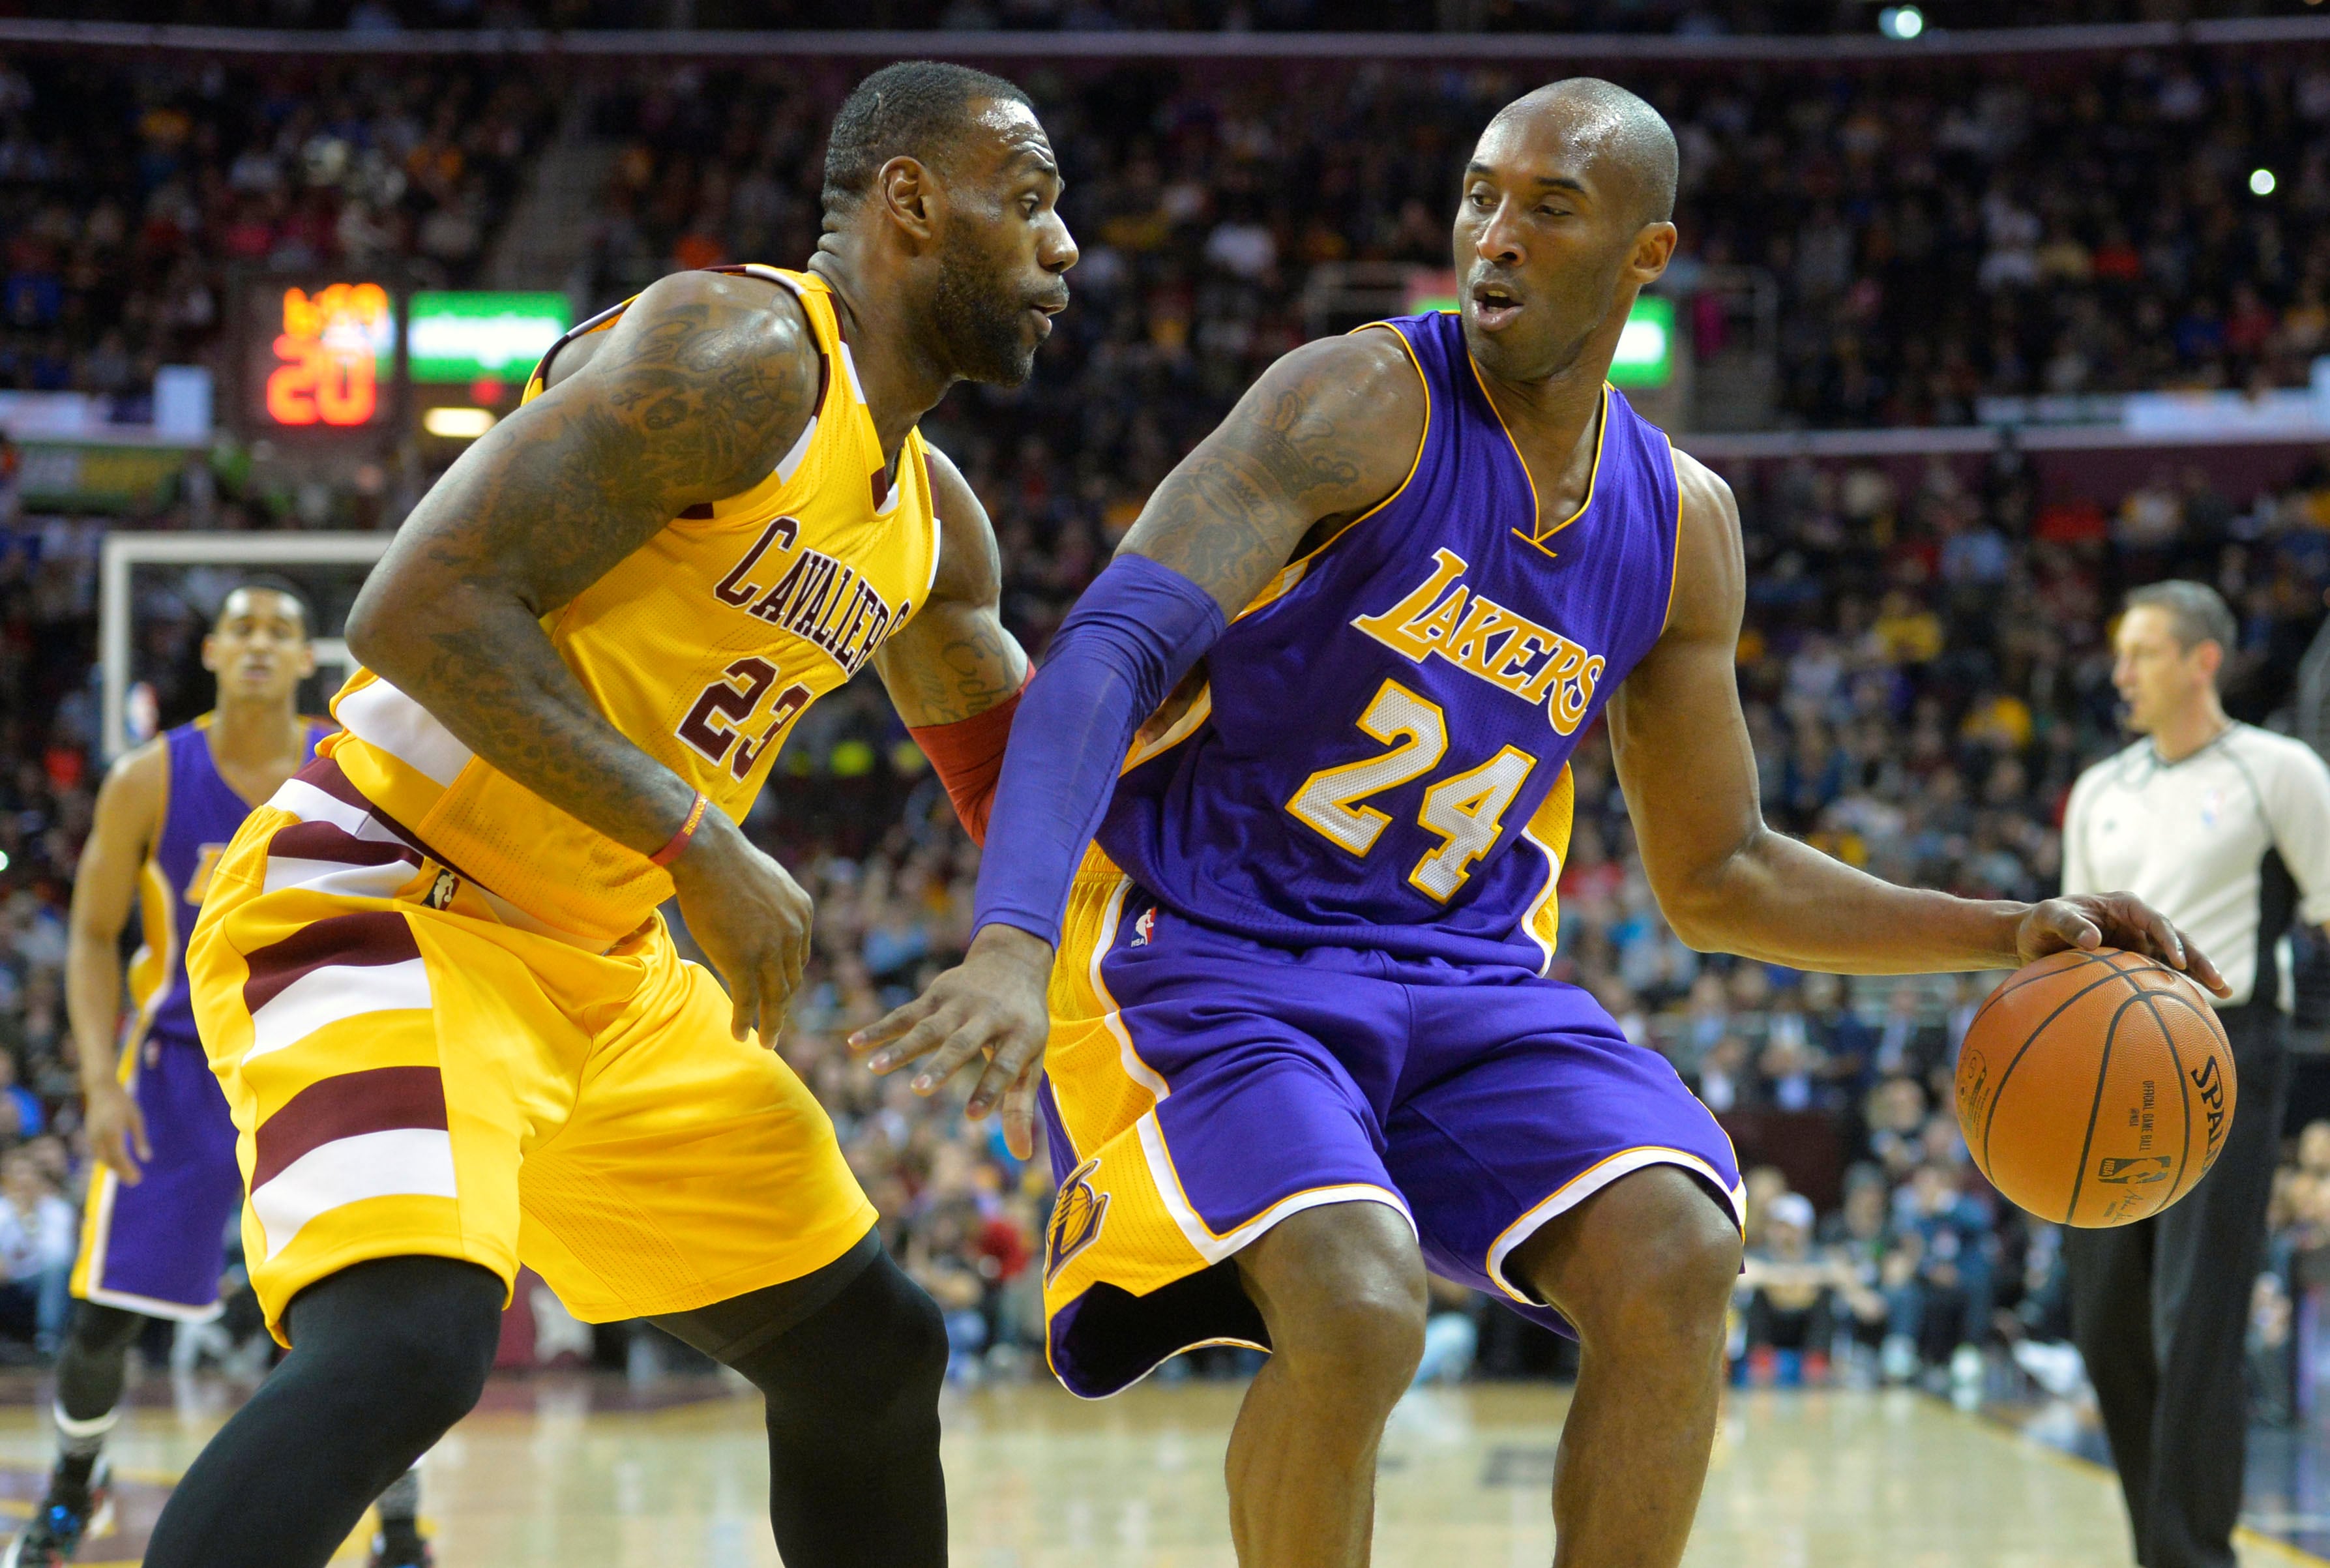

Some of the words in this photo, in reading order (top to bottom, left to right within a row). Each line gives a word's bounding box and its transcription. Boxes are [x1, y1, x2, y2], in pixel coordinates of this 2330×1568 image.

[267, 335, 377, 426] 20
[1349, 547, 1606, 736] LAKERS
[673, 655, 814, 784] 23
[1284, 677, 1537, 904] 24
[2141, 1113, 2154, 1132] GAME
[2142, 1080, 2154, 1111] OFFICIAL
[2102, 1160, 2116, 1176] NBA
[2139, 1135, 2153, 1151] BALL
